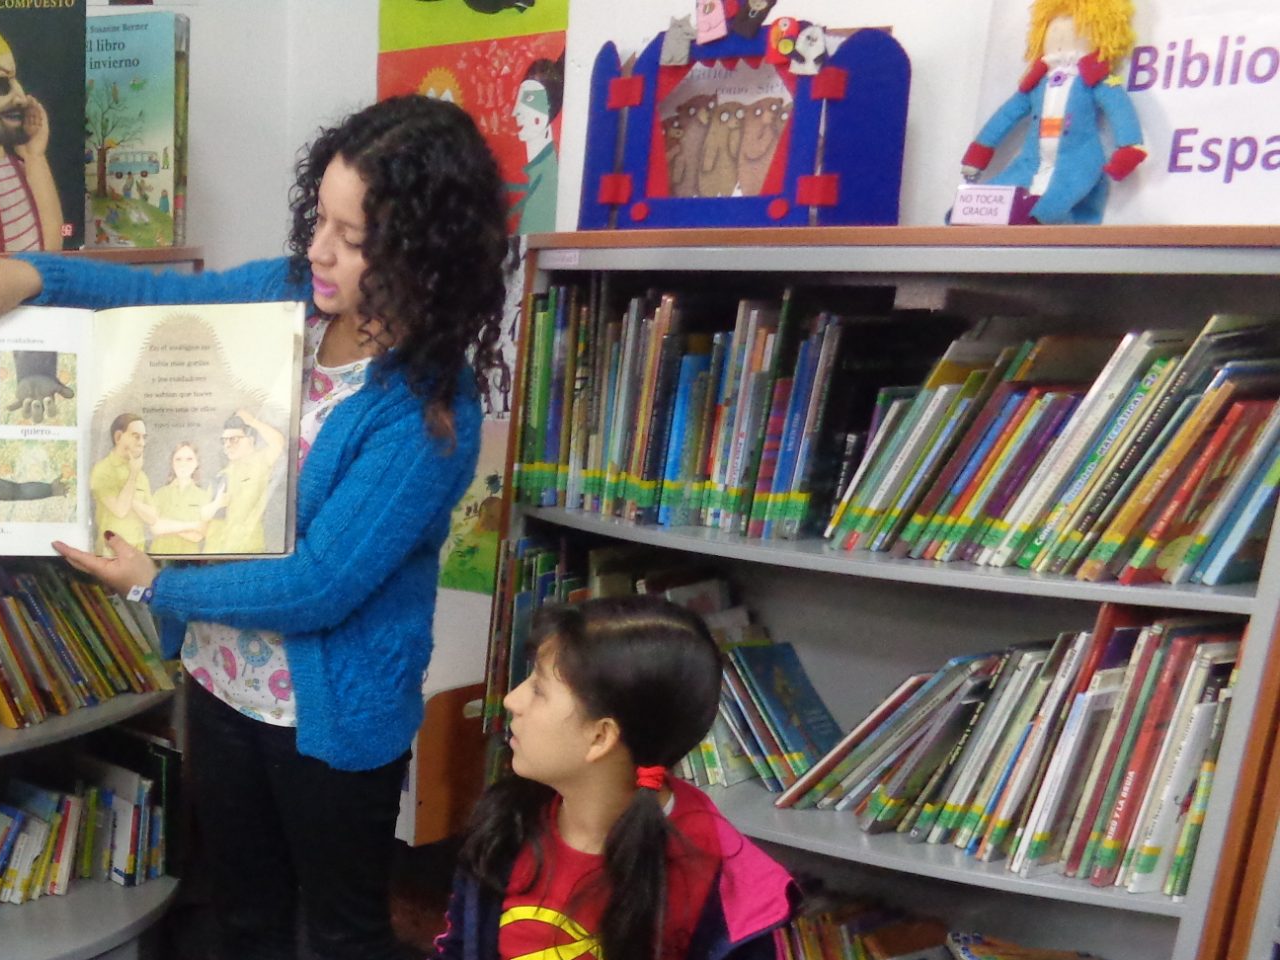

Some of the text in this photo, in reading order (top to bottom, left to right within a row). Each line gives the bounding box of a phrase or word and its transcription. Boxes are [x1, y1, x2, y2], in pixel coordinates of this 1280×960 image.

[96, 38, 125, 52] libro
[89, 56, 140, 69] invierno
[1127, 35, 1280, 92] Biblio
[1167, 127, 1280, 184] Espa
[960, 194, 973, 203] NO
[962, 206, 999, 217] GRACIAS
